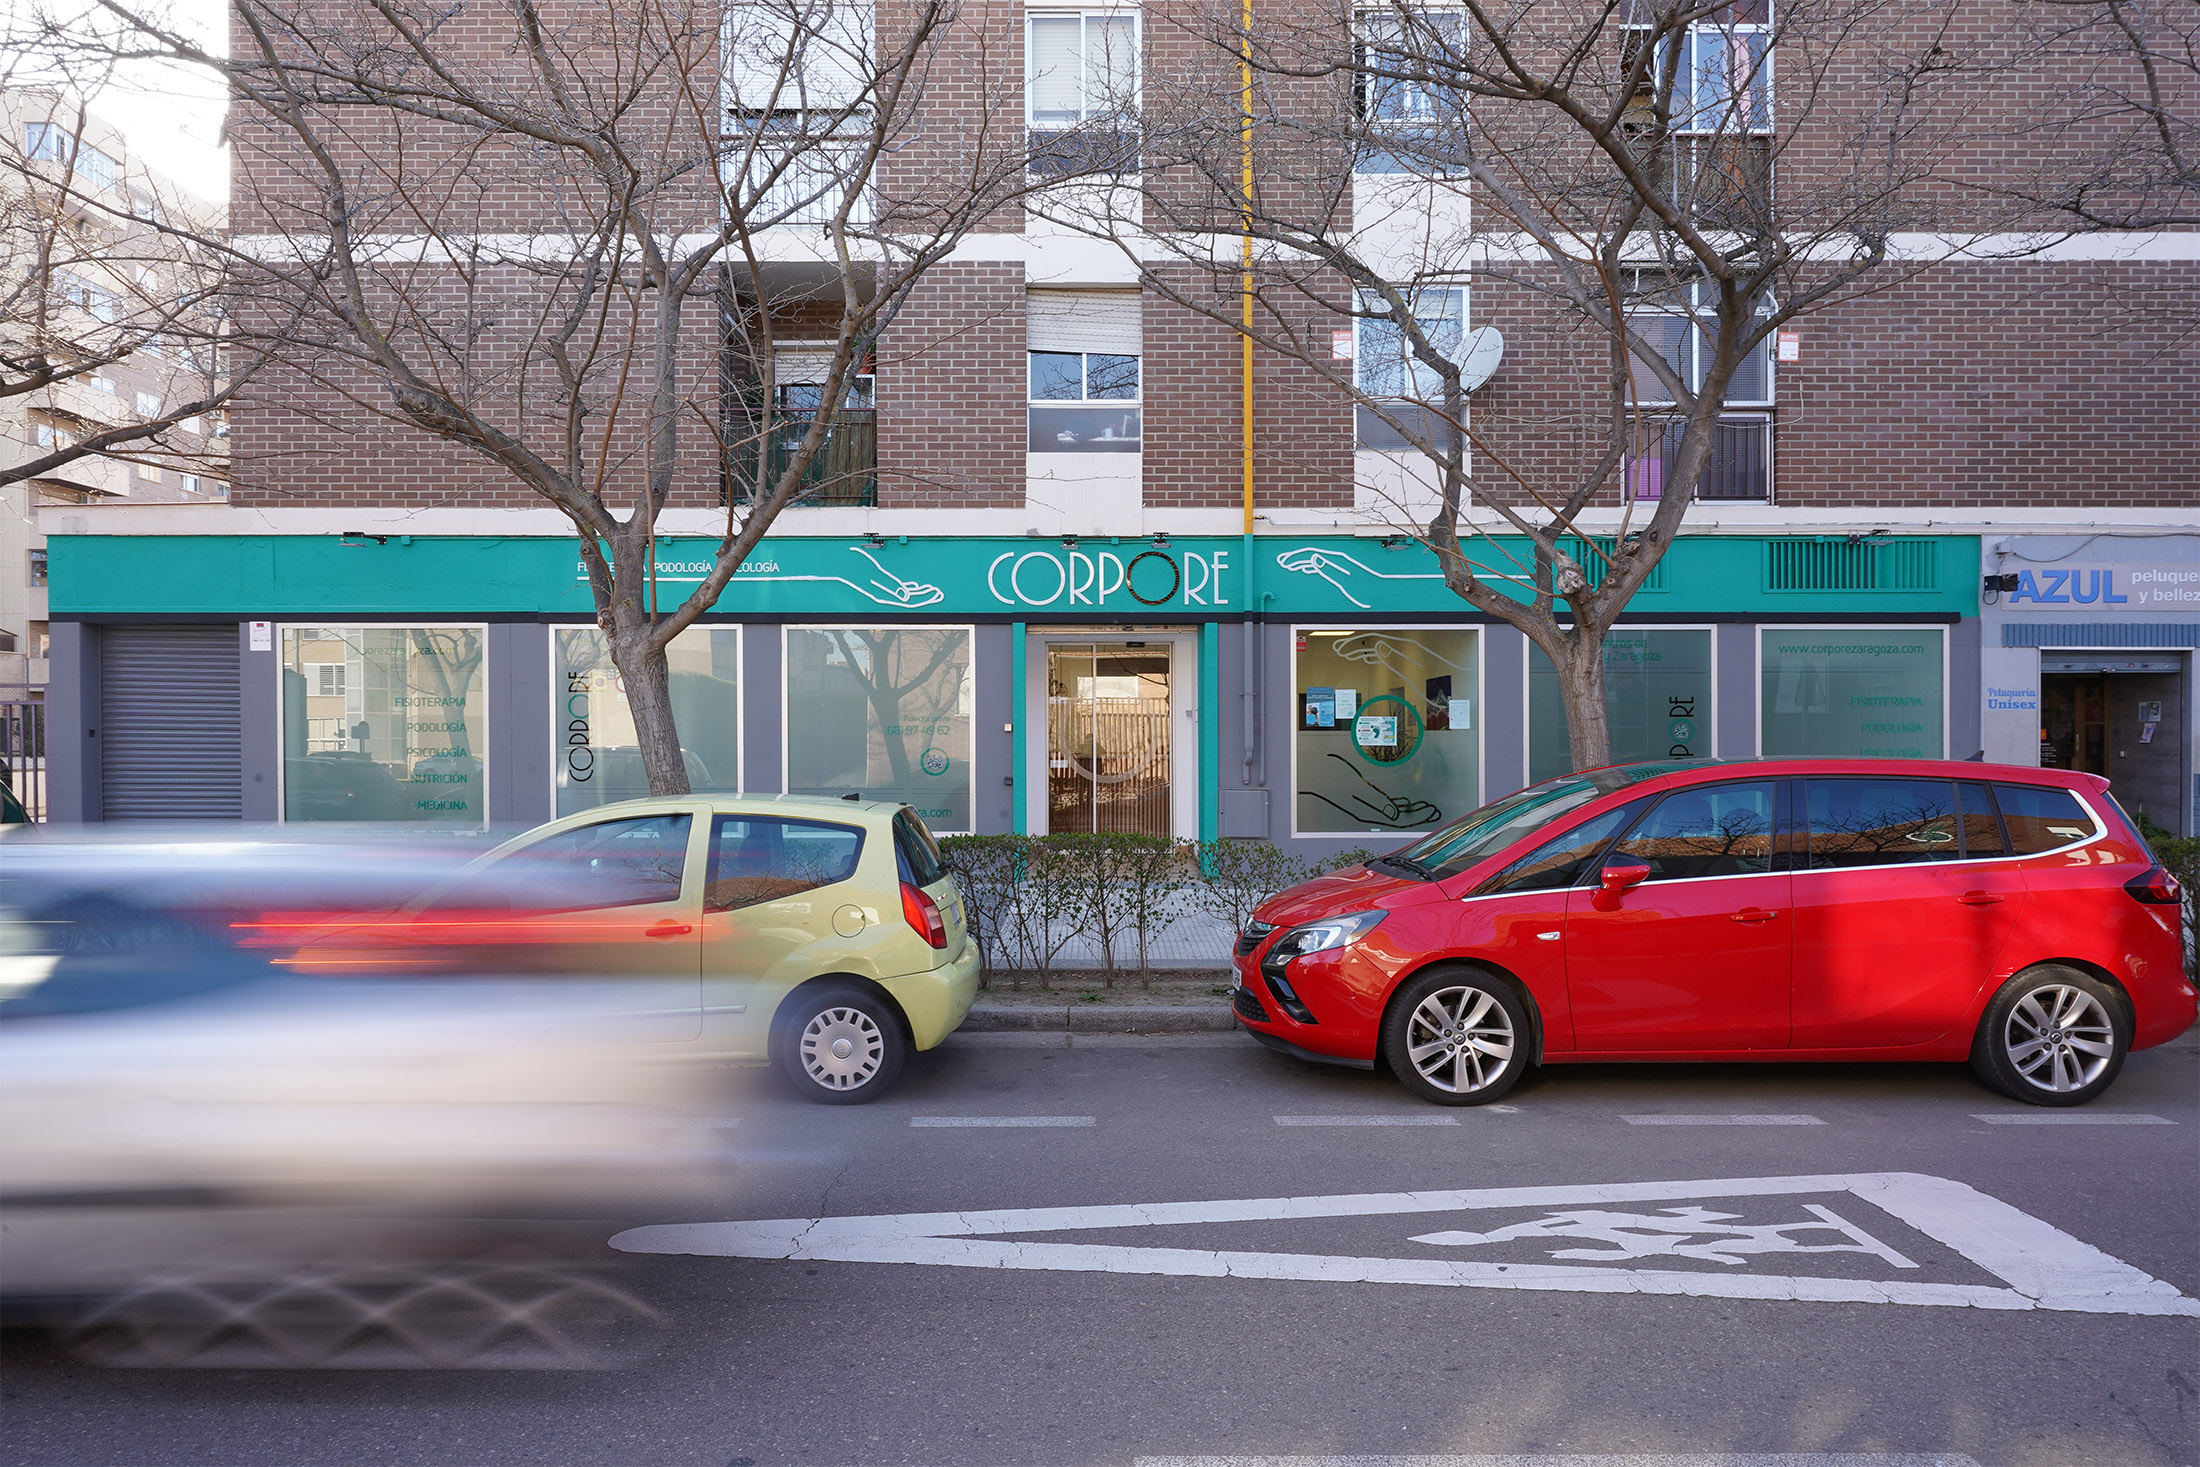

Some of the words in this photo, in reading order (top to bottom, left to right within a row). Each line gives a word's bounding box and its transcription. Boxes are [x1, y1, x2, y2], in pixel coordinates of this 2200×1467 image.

[655, 559, 712, 572] PODOLOGÍA
[734, 559, 780, 572] COLOGÍA
[988, 551, 1229, 606] CORPORE
[2132, 569, 2200, 585] peluque
[2008, 569, 2128, 604] AZUL
[2139, 591, 2148, 604] y
[1779, 645, 1924, 656] www.corporezaragoza.com
[1612, 651, 1661, 663] Zaragoza
[394, 697, 466, 707] FISIOTERAPIA
[1851, 696, 1923, 707] FISIOTERAPIA
[1987, 699, 2036, 709] Unisex
[407, 720, 467, 732] PODOLOGÍA
[568, 671, 594, 782] CORPORE
[906, 725, 919, 735] 97
[921, 725, 935, 735] 49
[937, 725, 950, 735] 62
[1668, 696, 1694, 760] PORE
[406, 745, 467, 757] PSICOLOGÍA
[410, 772, 468, 784] NUTRICIÓN
[416, 800, 468, 810] MEDICINA
